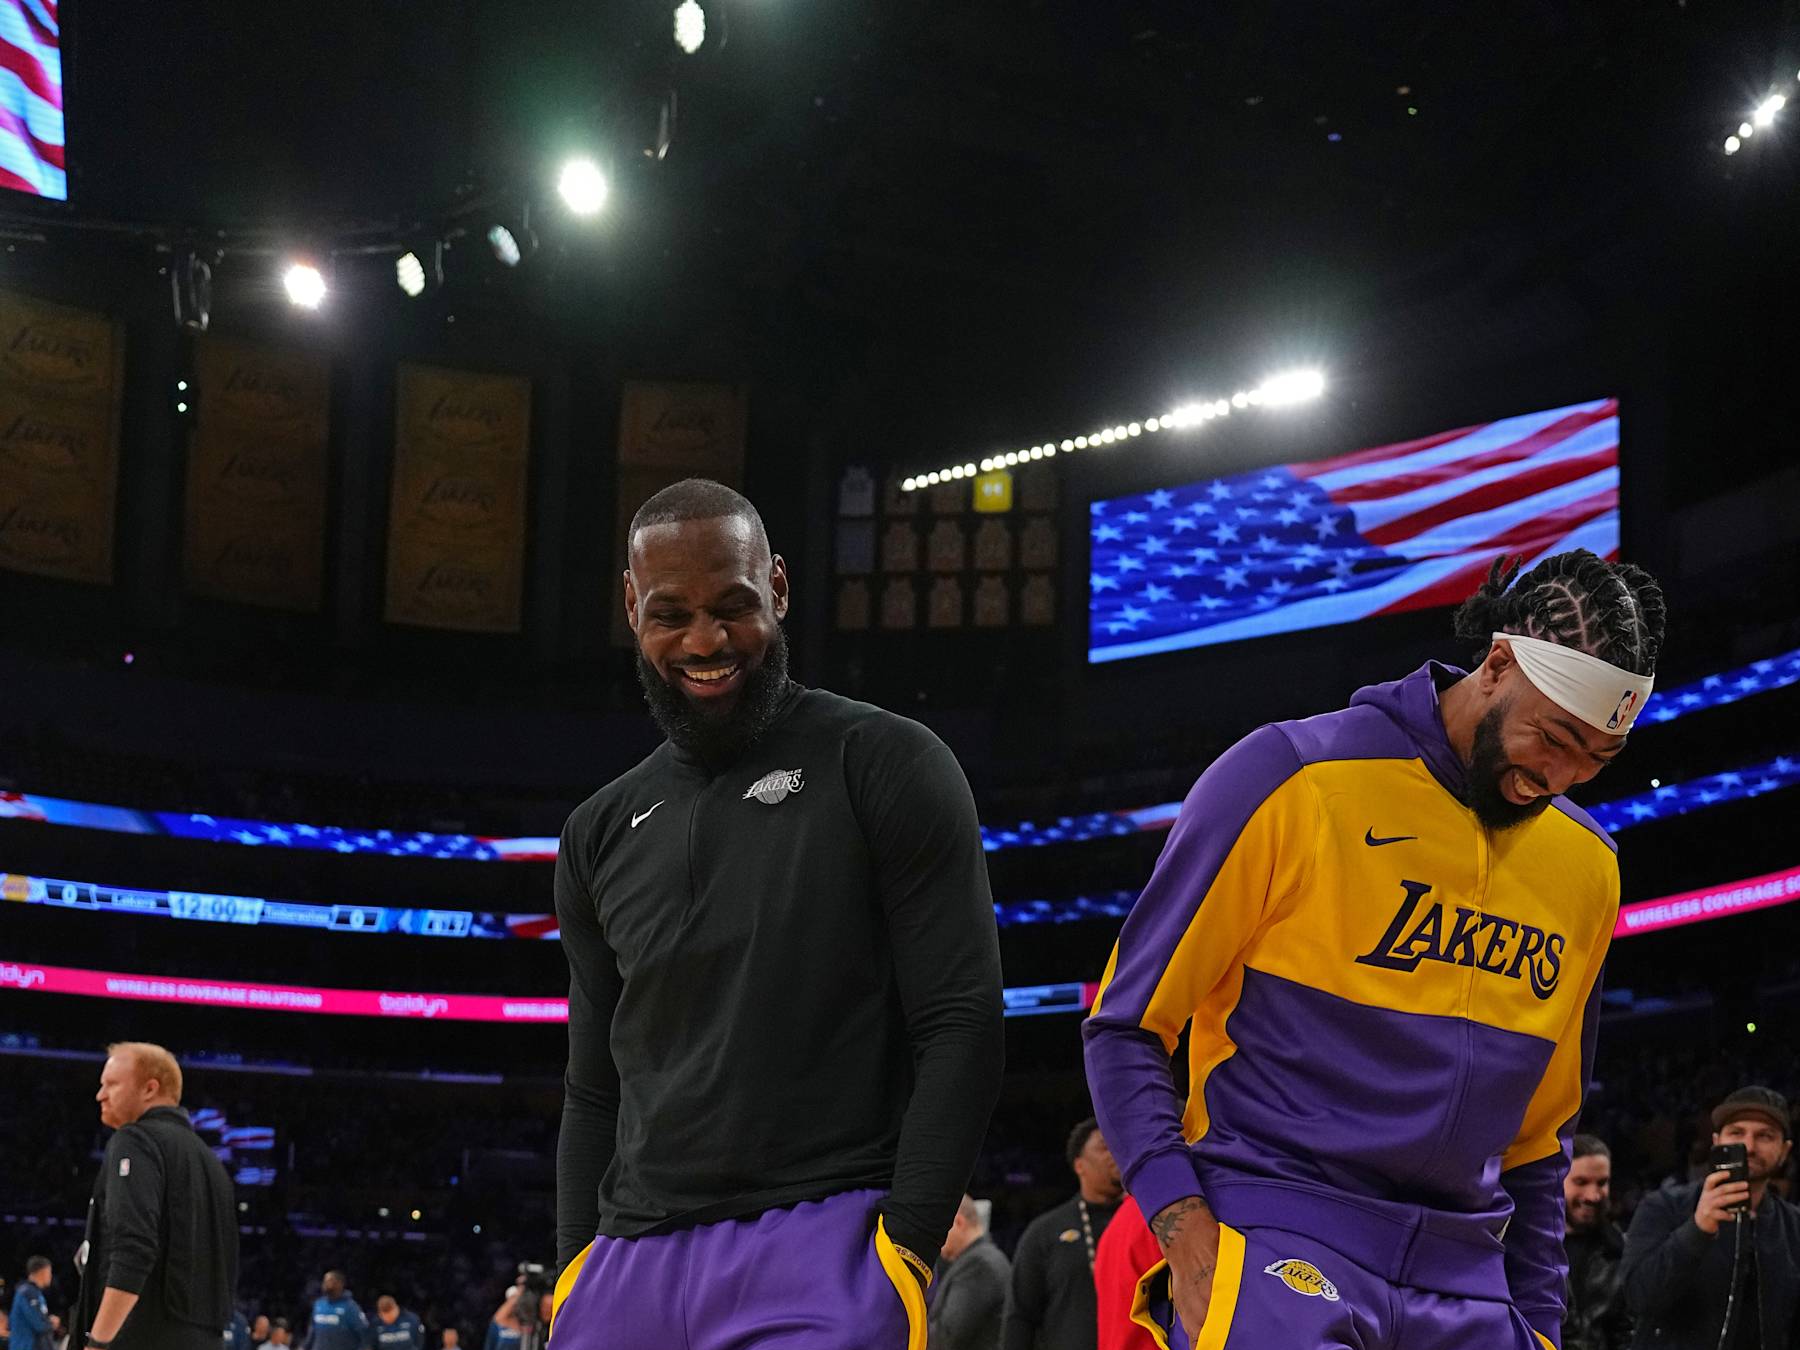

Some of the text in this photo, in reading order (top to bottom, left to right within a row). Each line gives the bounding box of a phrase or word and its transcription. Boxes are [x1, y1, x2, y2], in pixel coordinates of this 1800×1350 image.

[742, 773, 806, 799] LAKERS
[1624, 898, 1700, 928] WIRELESS
[1702, 880, 1784, 912] COVERAGE
[1354, 879, 1566, 1000] LAKERS
[106, 979, 176, 996] WIRELESS
[1266, 1262, 1338, 1299] LAKERS
